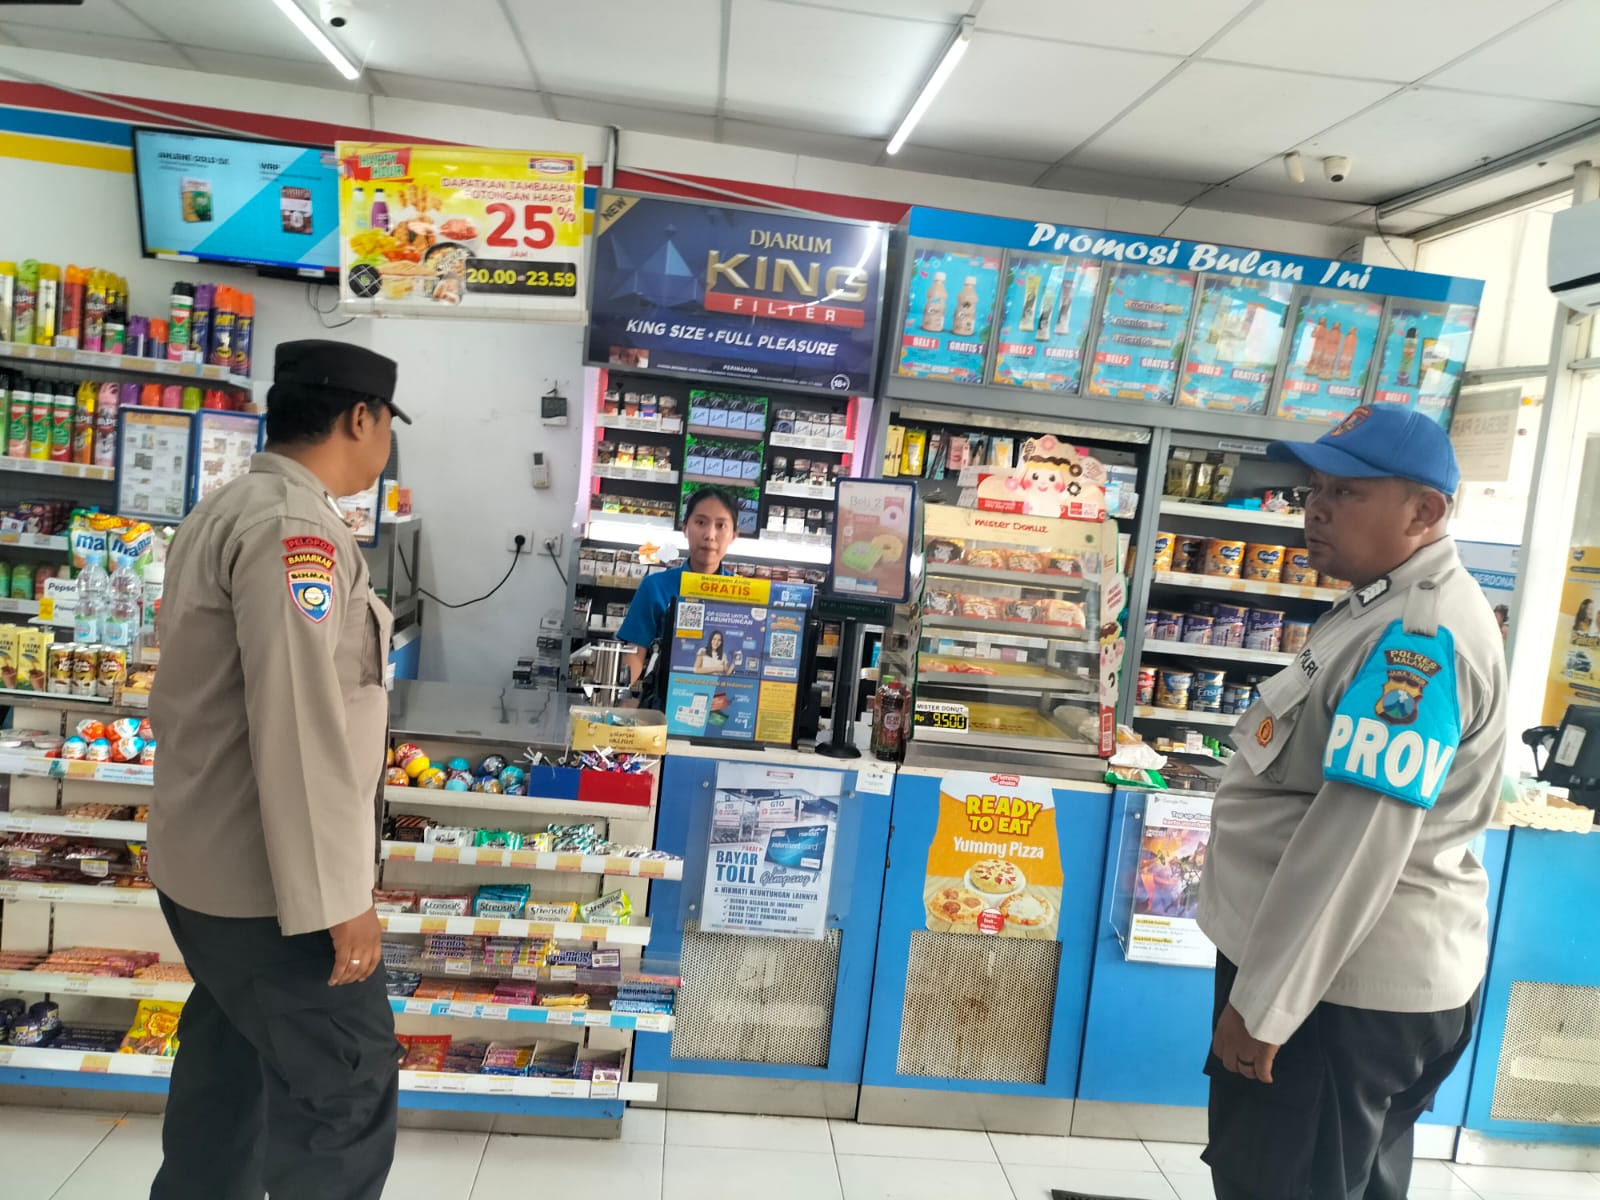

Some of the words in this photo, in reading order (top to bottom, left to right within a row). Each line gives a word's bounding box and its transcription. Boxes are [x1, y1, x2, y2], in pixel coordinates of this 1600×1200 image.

[441, 177, 506, 190] DAPATKAN
[508, 181, 576, 193] TAMBAHAN
[532, 191, 576, 204] HARGA
[601, 197, 627, 221] NEW
[750, 229, 832, 255] DJARUM
[1028, 222, 1180, 266] Promosi
[1188, 243, 1305, 281] Bulan
[1319, 261, 1372, 291] Ini
[707, 250, 868, 303] KING
[733, 298, 837, 322] FILTER
[625, 319, 666, 337] KING
[668, 324, 706, 341] SIZE
[713, 331, 754, 348] FULL
[757, 335, 839, 357] PLEASURE
[289, 537, 334, 554] PELOPOR
[700, 582, 750, 597] GRATIS
[1390, 650, 1438, 671] POLRES
[1392, 656, 1431, 672] MALANG
[917, 703, 940, 711] MISTER
[941, 705, 964, 713] DONUT
[1324, 714, 1454, 798] PROV
[770, 801, 785, 809] GTO
[966, 796, 1042, 820] READY
[970, 816, 994, 833] TO
[998, 817, 1032, 836] EAT
[716, 850, 758, 865] BAYAR
[953, 836, 1007, 858] Yummy
[1009, 842, 1044, 860] Pizza
[715, 864, 756, 884] TOLL
[585, 893, 621, 914] Strepsils
[749, 889, 790, 898] KEUNTUNGAN
[792, 891, 818, 901] LAINNYA
[480, 902, 517, 914] Strepsils
[431, 940, 467, 948] mentos
